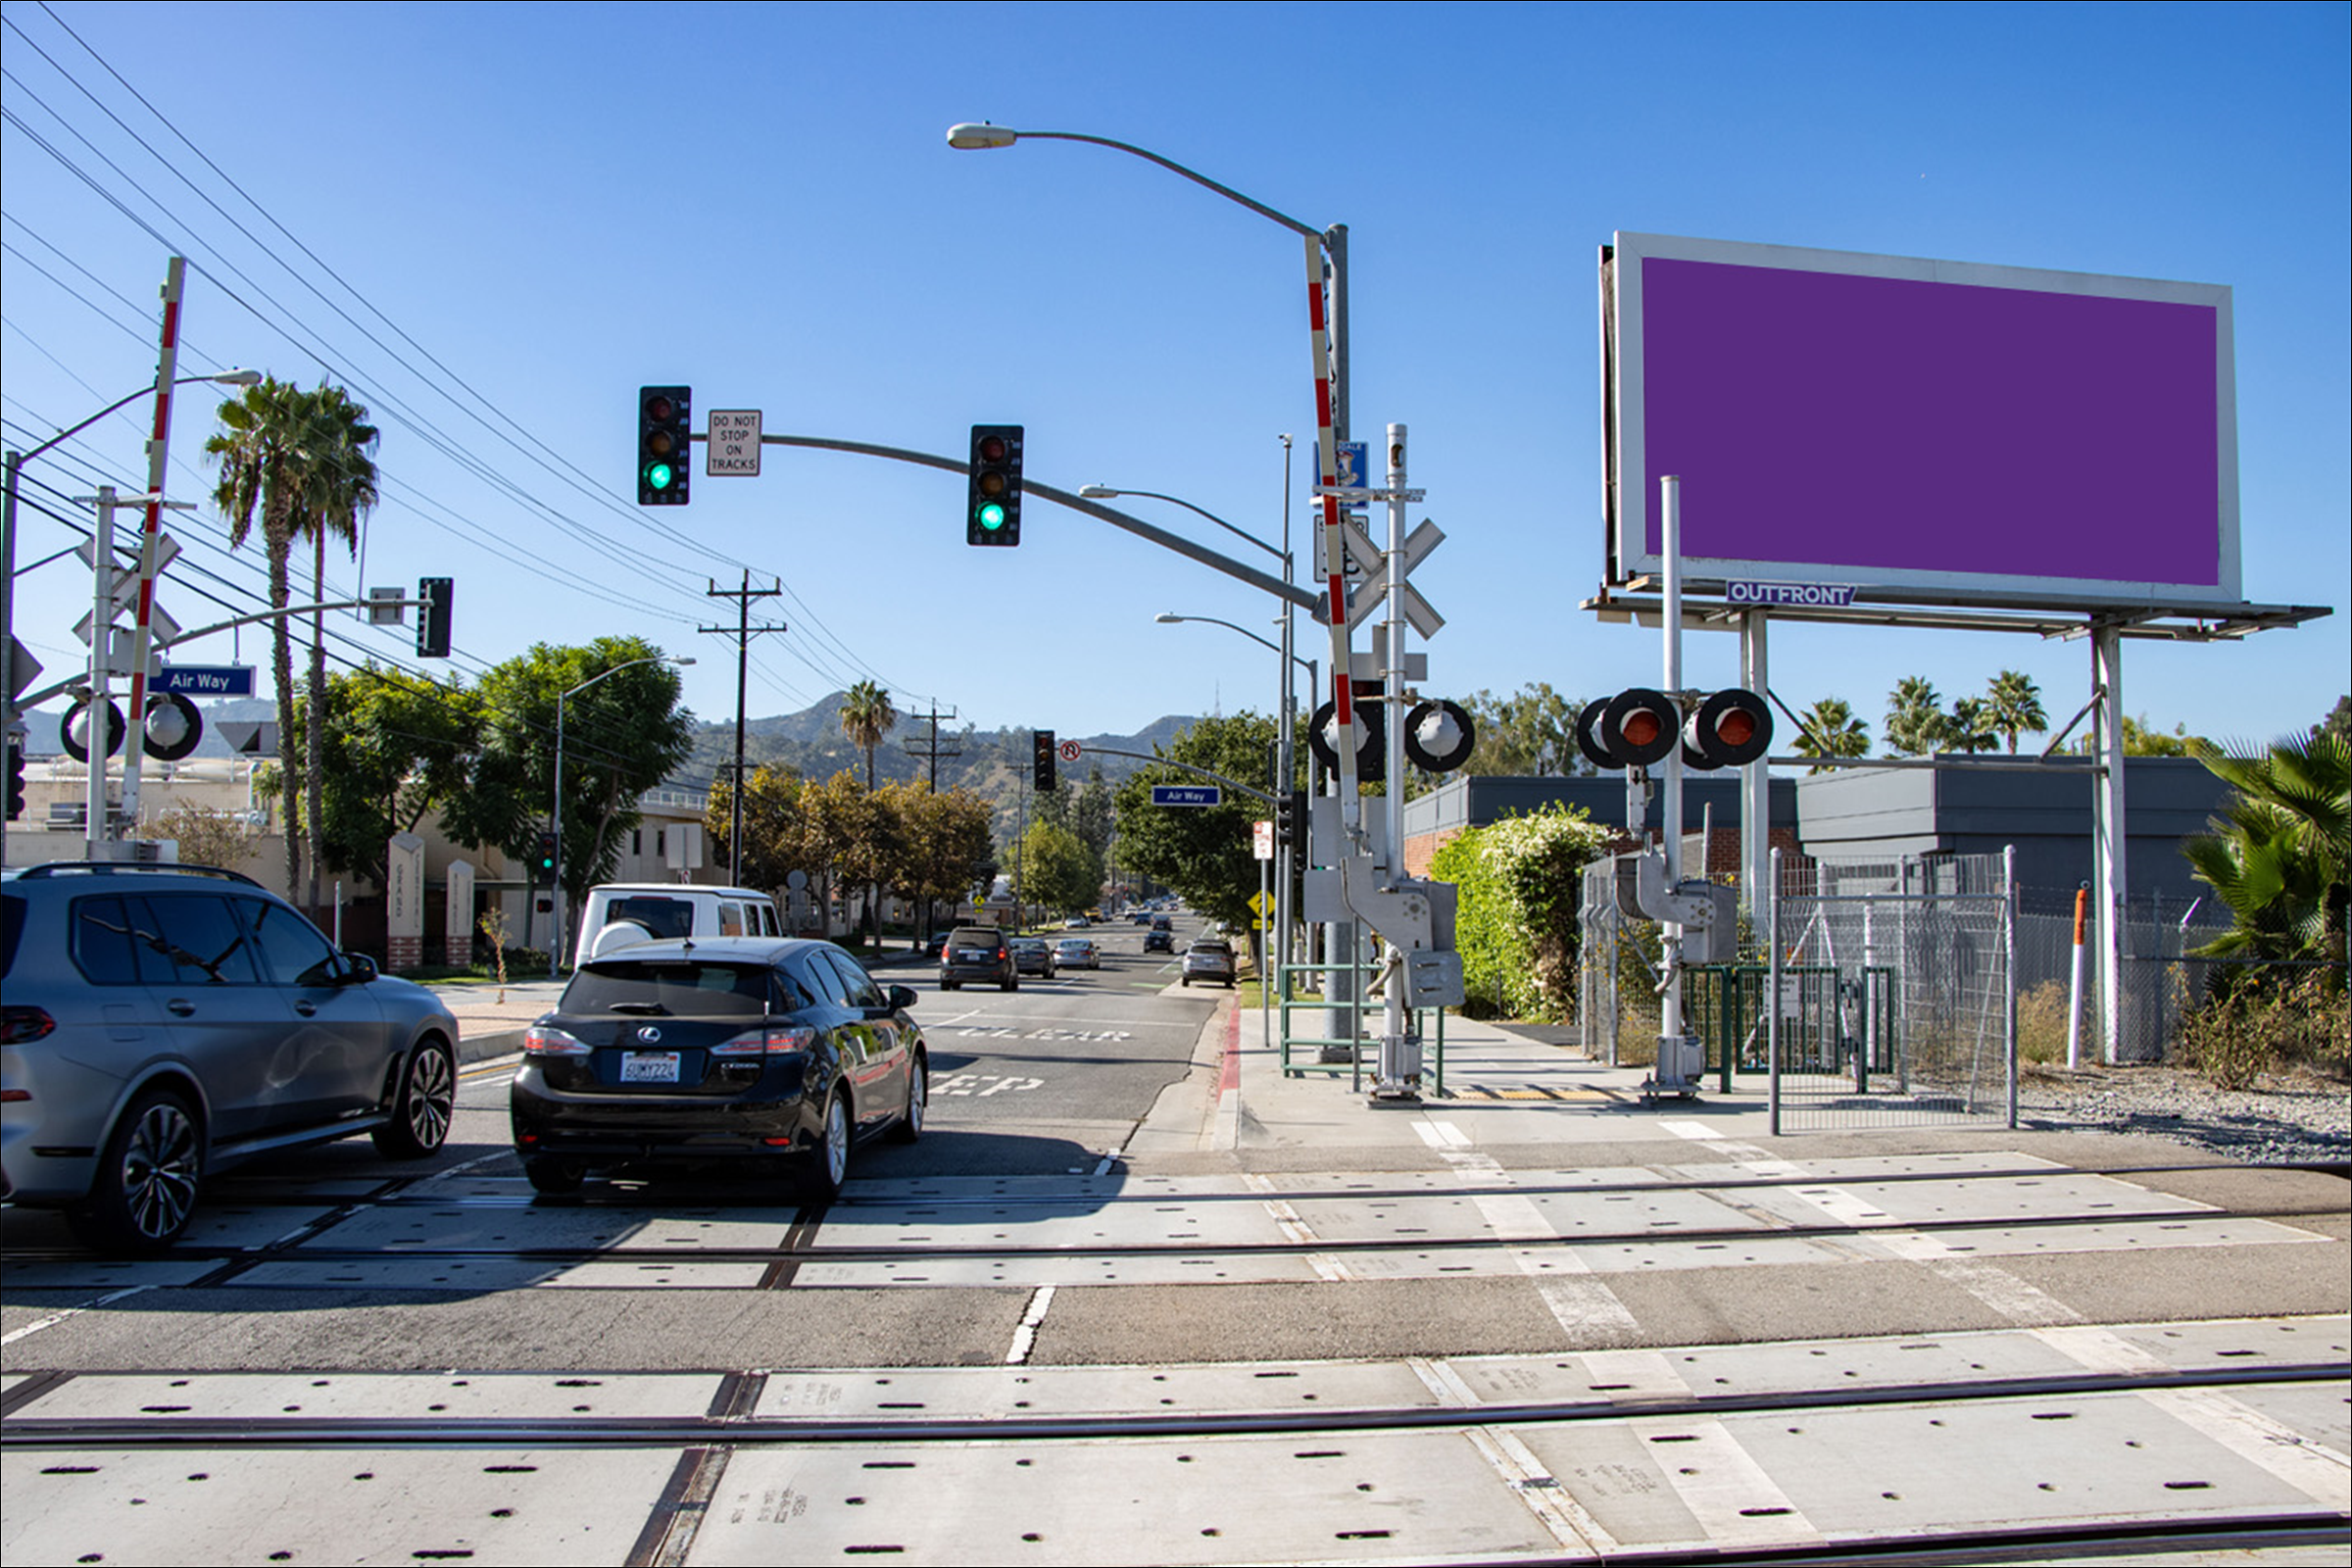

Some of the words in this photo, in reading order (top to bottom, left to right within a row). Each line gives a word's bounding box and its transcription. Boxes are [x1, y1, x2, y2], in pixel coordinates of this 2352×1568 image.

[713, 416, 729, 426] DO
[735, 416, 756, 426] NOT
[720, 429, 749, 441] STOP
[726, 445, 742, 456] ON
[712, 459, 756, 469] TRACKS
[1731, 583, 1849, 605] OUTFRONT
[170, 673, 194, 688] Air
[198, 673, 229, 691] Way
[1167, 791, 1182, 801] Air
[1184, 791, 1205, 803] Way
[957, 1027, 1130, 1042] CLEAR
